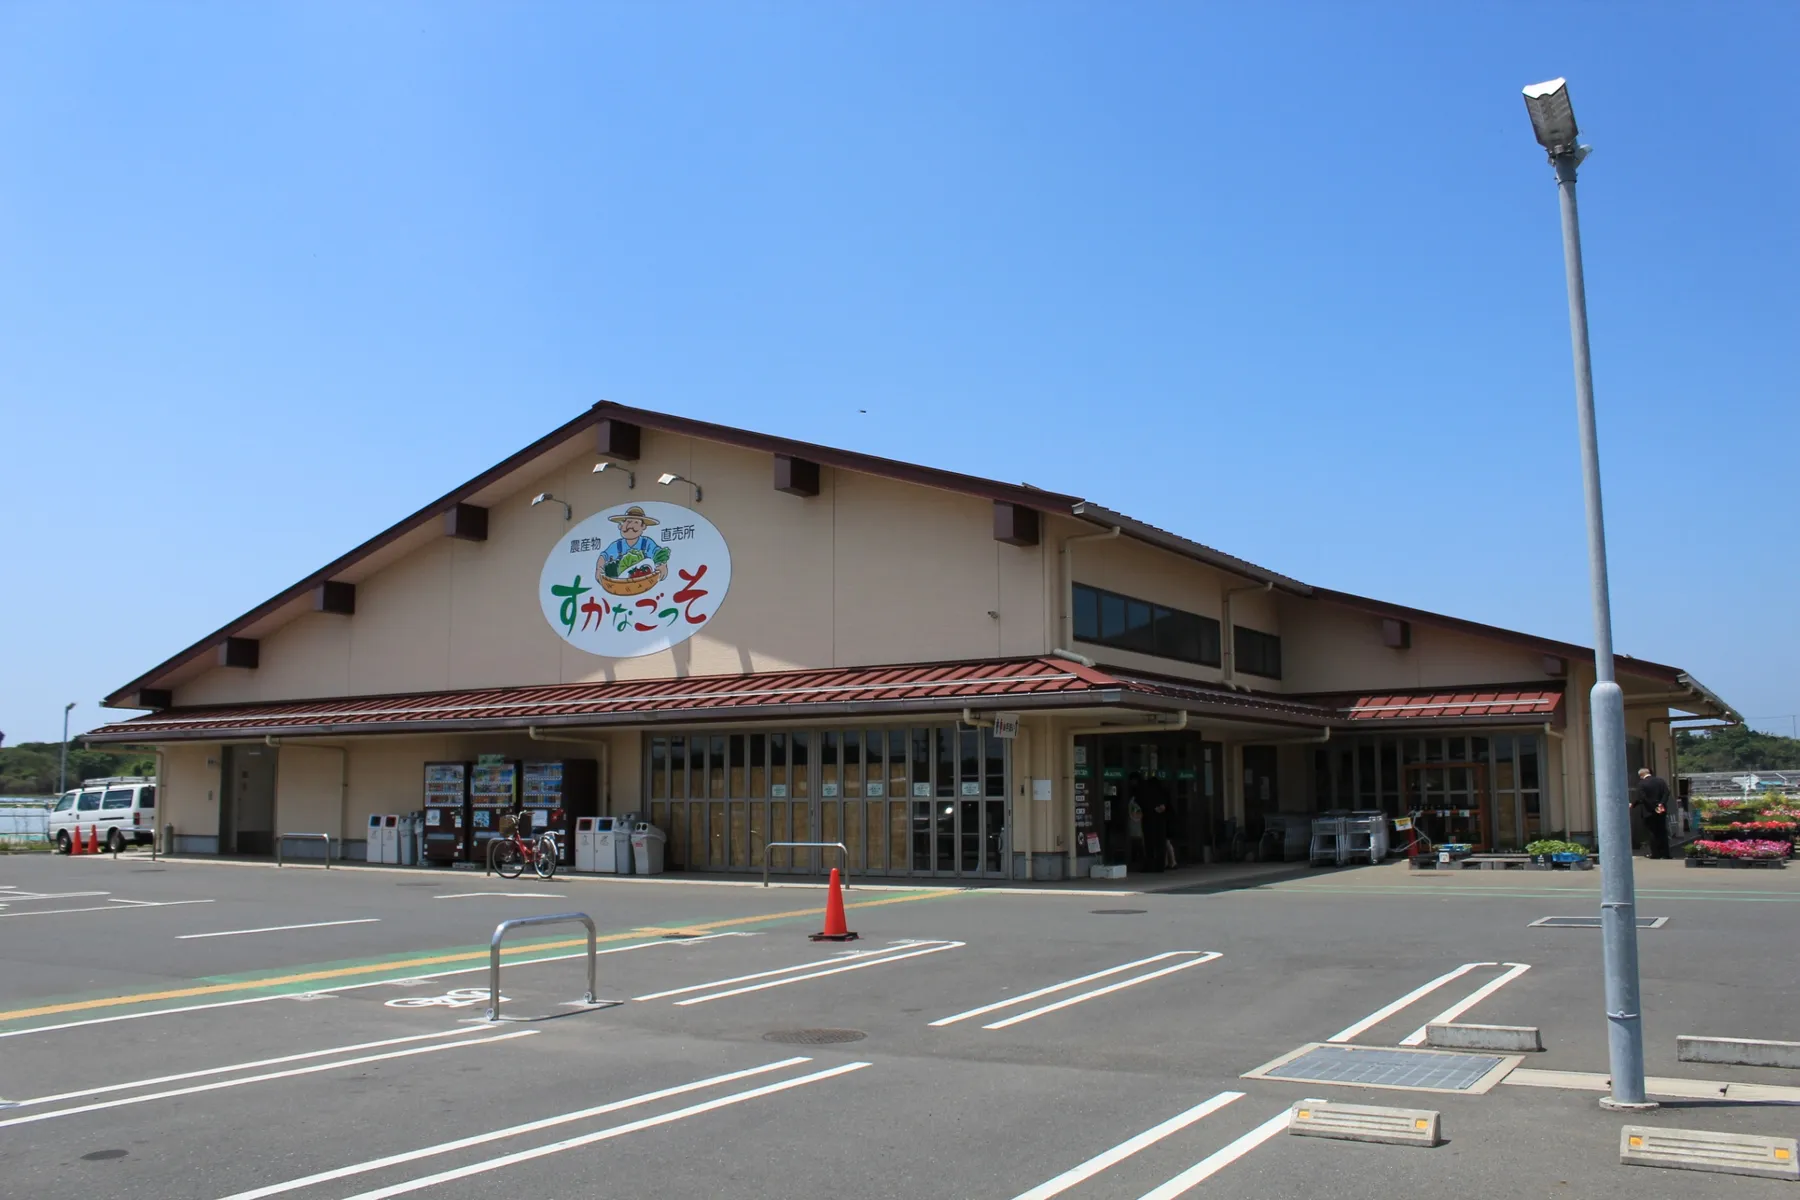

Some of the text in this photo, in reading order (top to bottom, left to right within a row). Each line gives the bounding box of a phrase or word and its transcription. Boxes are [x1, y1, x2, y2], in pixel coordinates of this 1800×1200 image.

[570, 525, 695, 553] 農産物 直売所
[551, 564, 708, 637] すかなごっそ
